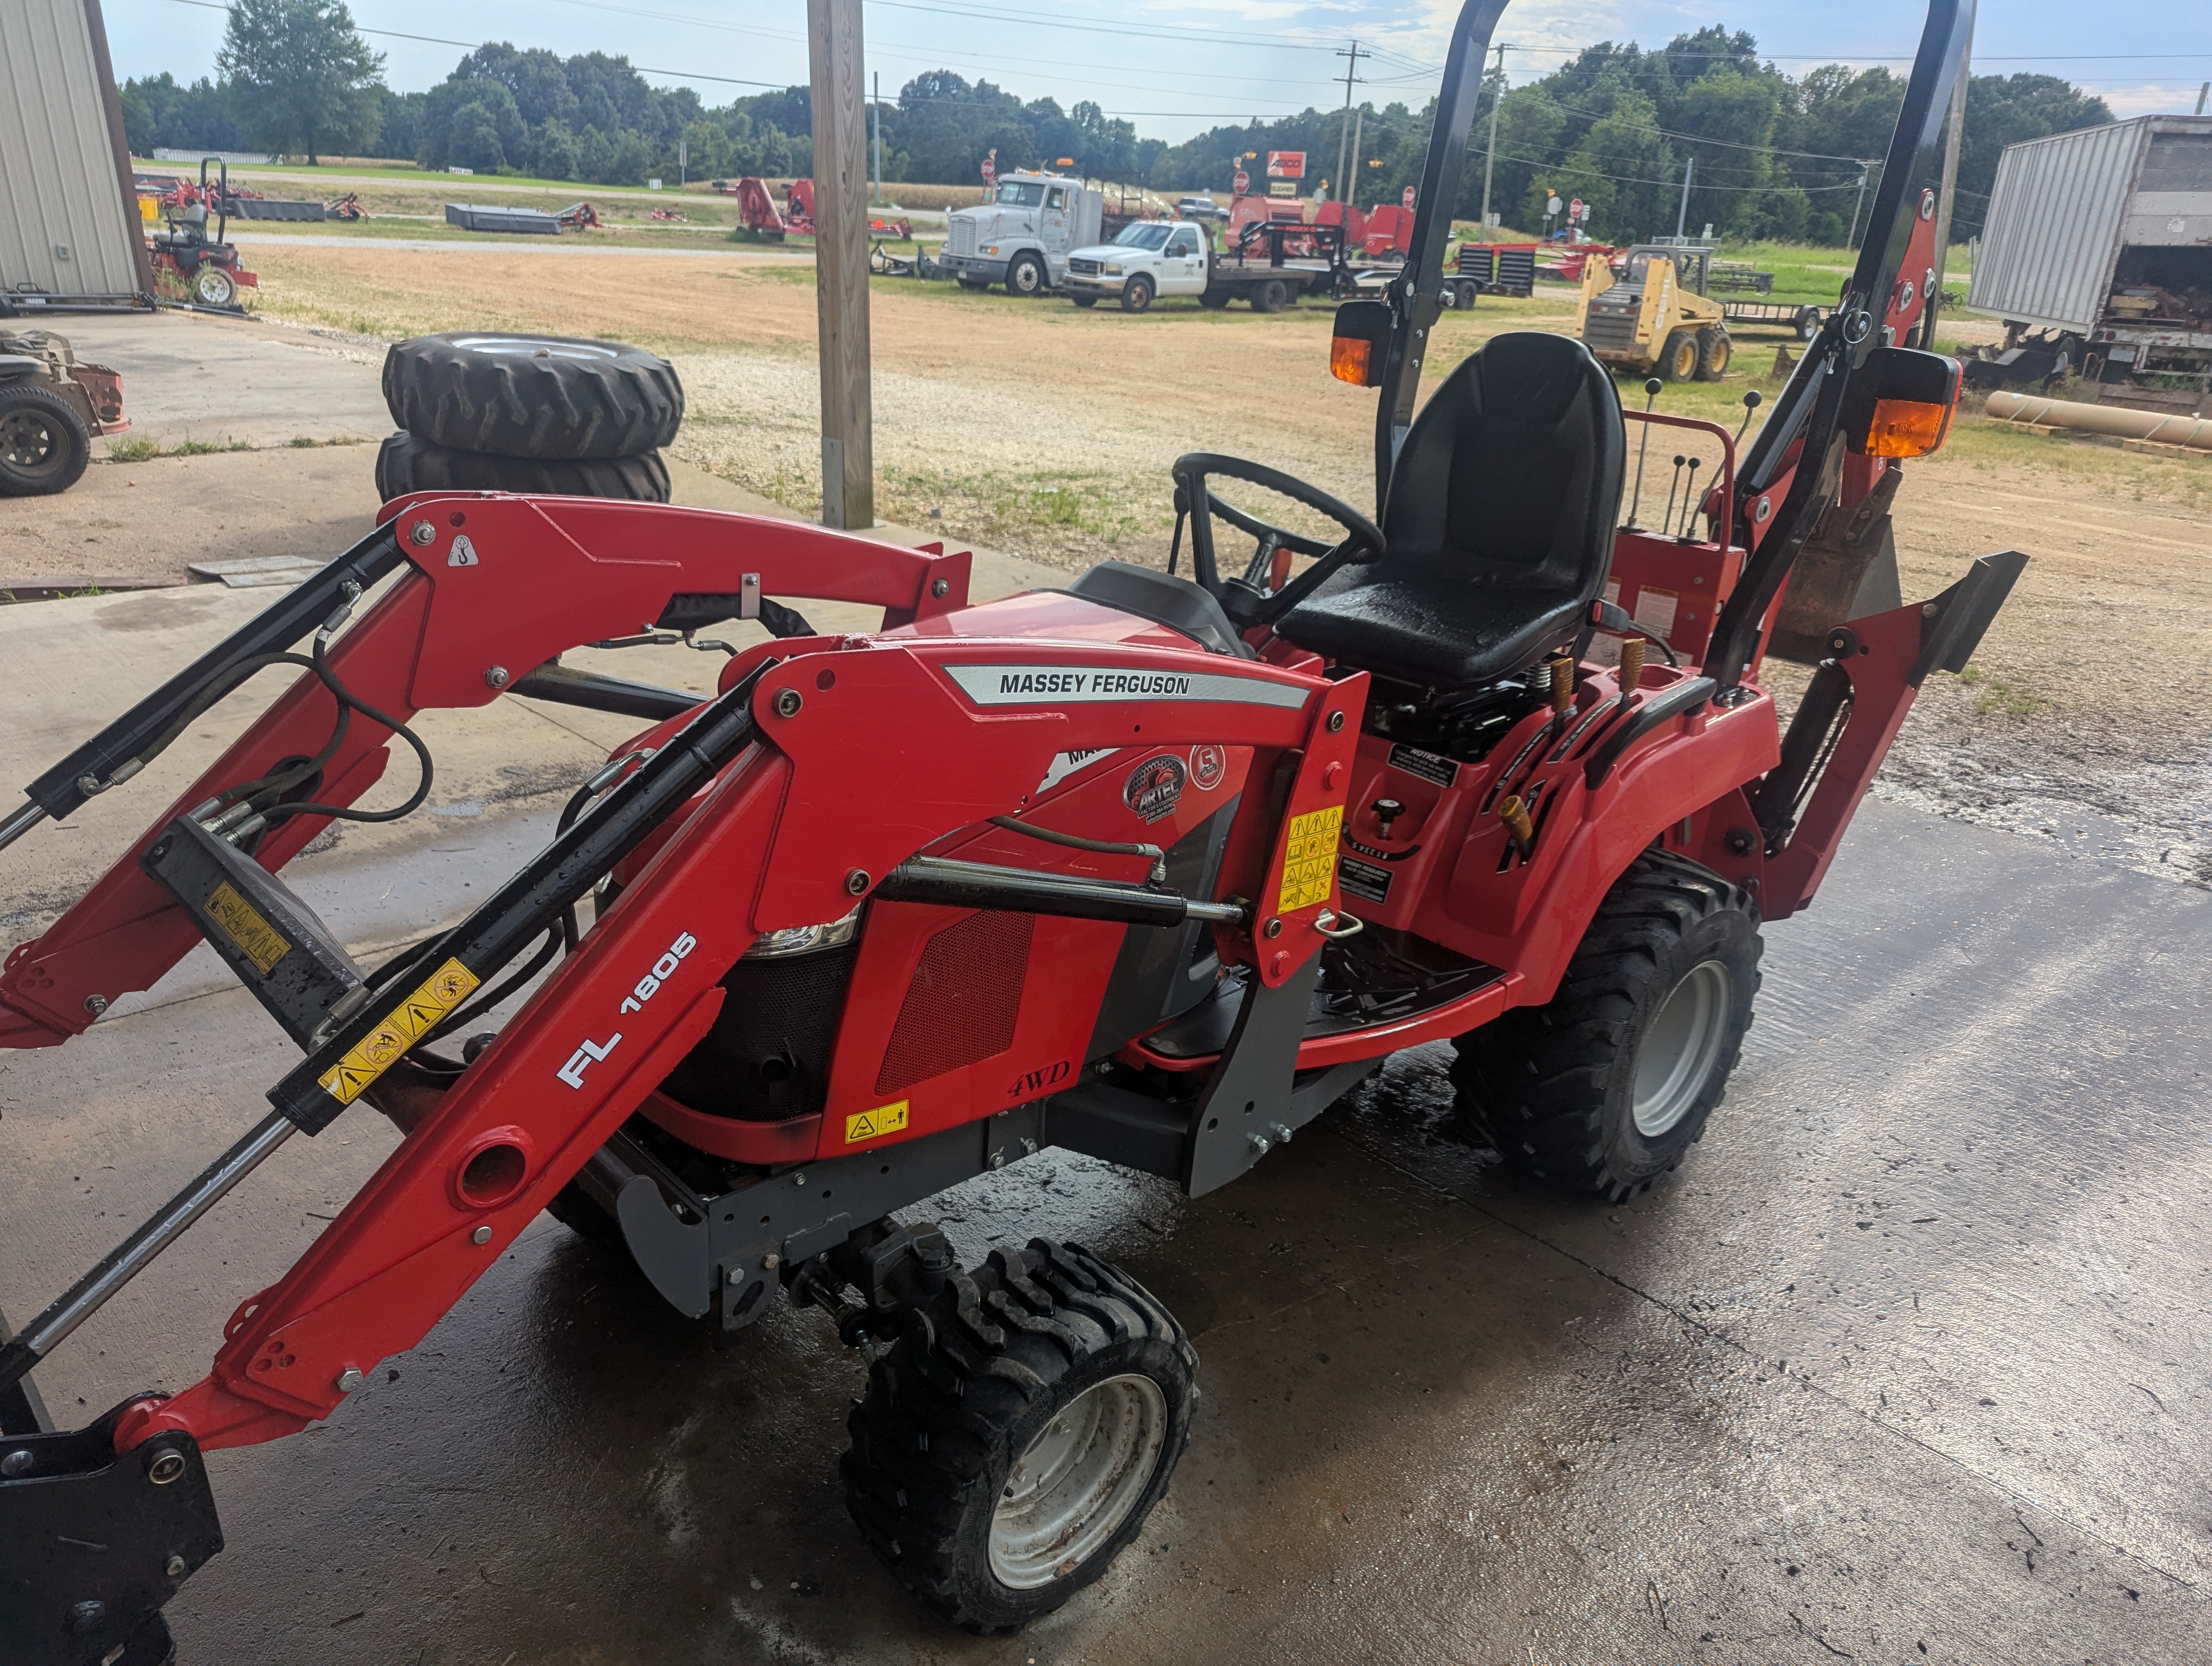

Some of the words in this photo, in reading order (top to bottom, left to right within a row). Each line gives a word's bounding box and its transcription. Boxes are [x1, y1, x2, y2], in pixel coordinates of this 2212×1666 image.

[1271, 159, 1301, 168] AGCO
[1000, 674, 1087, 694] MASSEY
[1092, 675, 1191, 694] FERGUSON
[1201, 748, 1213, 765] 5
[1410, 748, 1442, 764] NOTICE
[1139, 778, 1179, 812] ARTEC
[1139, 804, 1156, 817] TRACTOR
[1159, 793, 1180, 806] EQUIPMENT
[556, 1032, 622, 1090] FL
[620, 931, 697, 1014] 1805
[1007, 1060, 1070, 1098] 4WD
